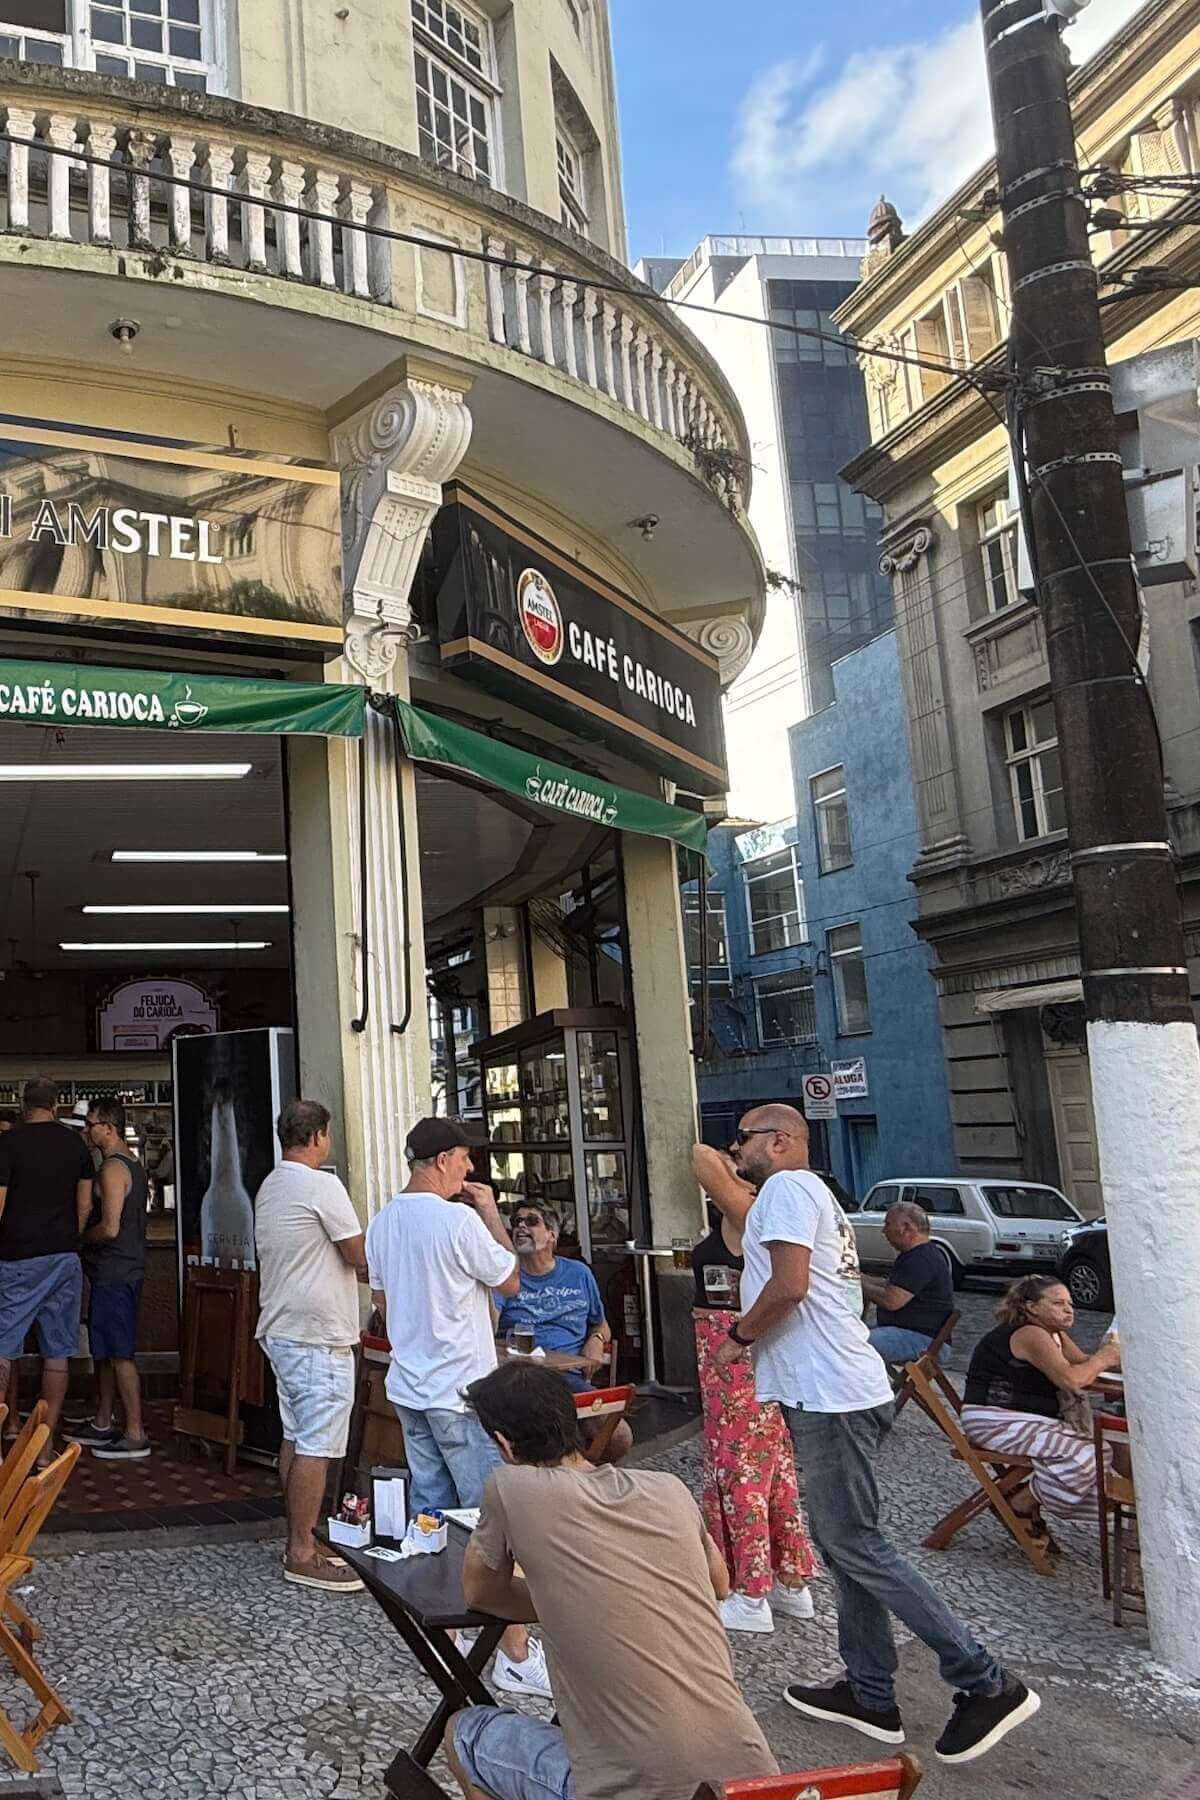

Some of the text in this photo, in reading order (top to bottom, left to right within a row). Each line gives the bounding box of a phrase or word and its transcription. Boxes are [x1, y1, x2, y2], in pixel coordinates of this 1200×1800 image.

[0, 495, 12, 538] I
[528, 598, 554, 623] AMSTEL
[569, 622, 696, 727] CAFÉ CARIOCA
[61, 688, 165, 721] CARIOCA
[540, 779, 605, 820] CAFÉ CARIOCA
[133, 1005, 184, 1018] DO CARIOCA
[833, 1073, 864, 1086] ALUGA
